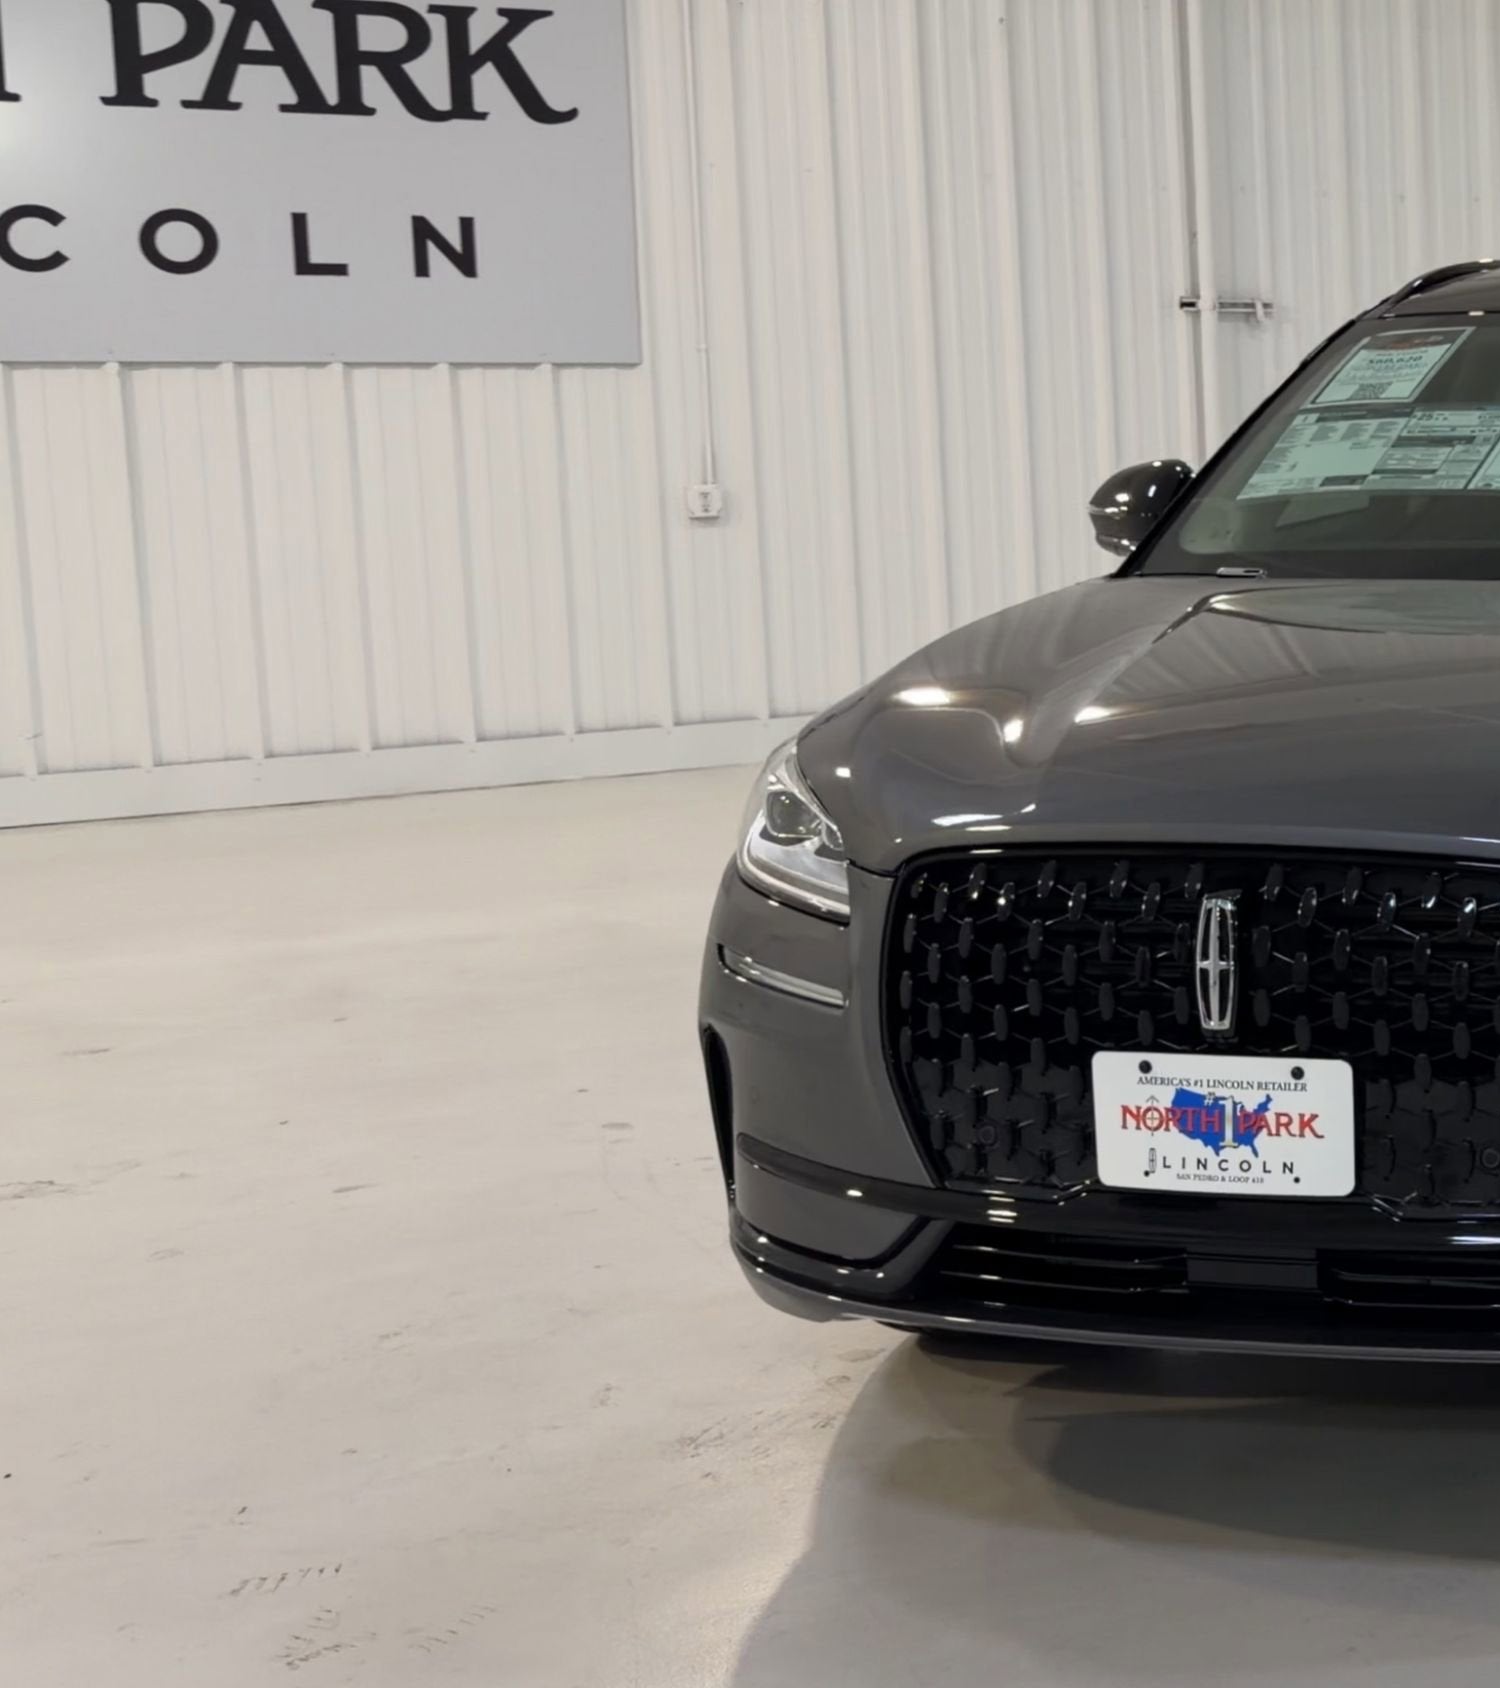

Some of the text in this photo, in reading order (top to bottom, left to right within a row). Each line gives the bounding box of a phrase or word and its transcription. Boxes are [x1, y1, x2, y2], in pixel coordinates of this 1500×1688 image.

[101, 0, 579, 125] PARK
[1137, 1076, 1308, 1092] AMERICA'S #1 LINCOLN RETAILER
[1121, 1104, 1325, 1138] NORTH PARK
[1162, 1155, 1294, 1174] LINCOLN
